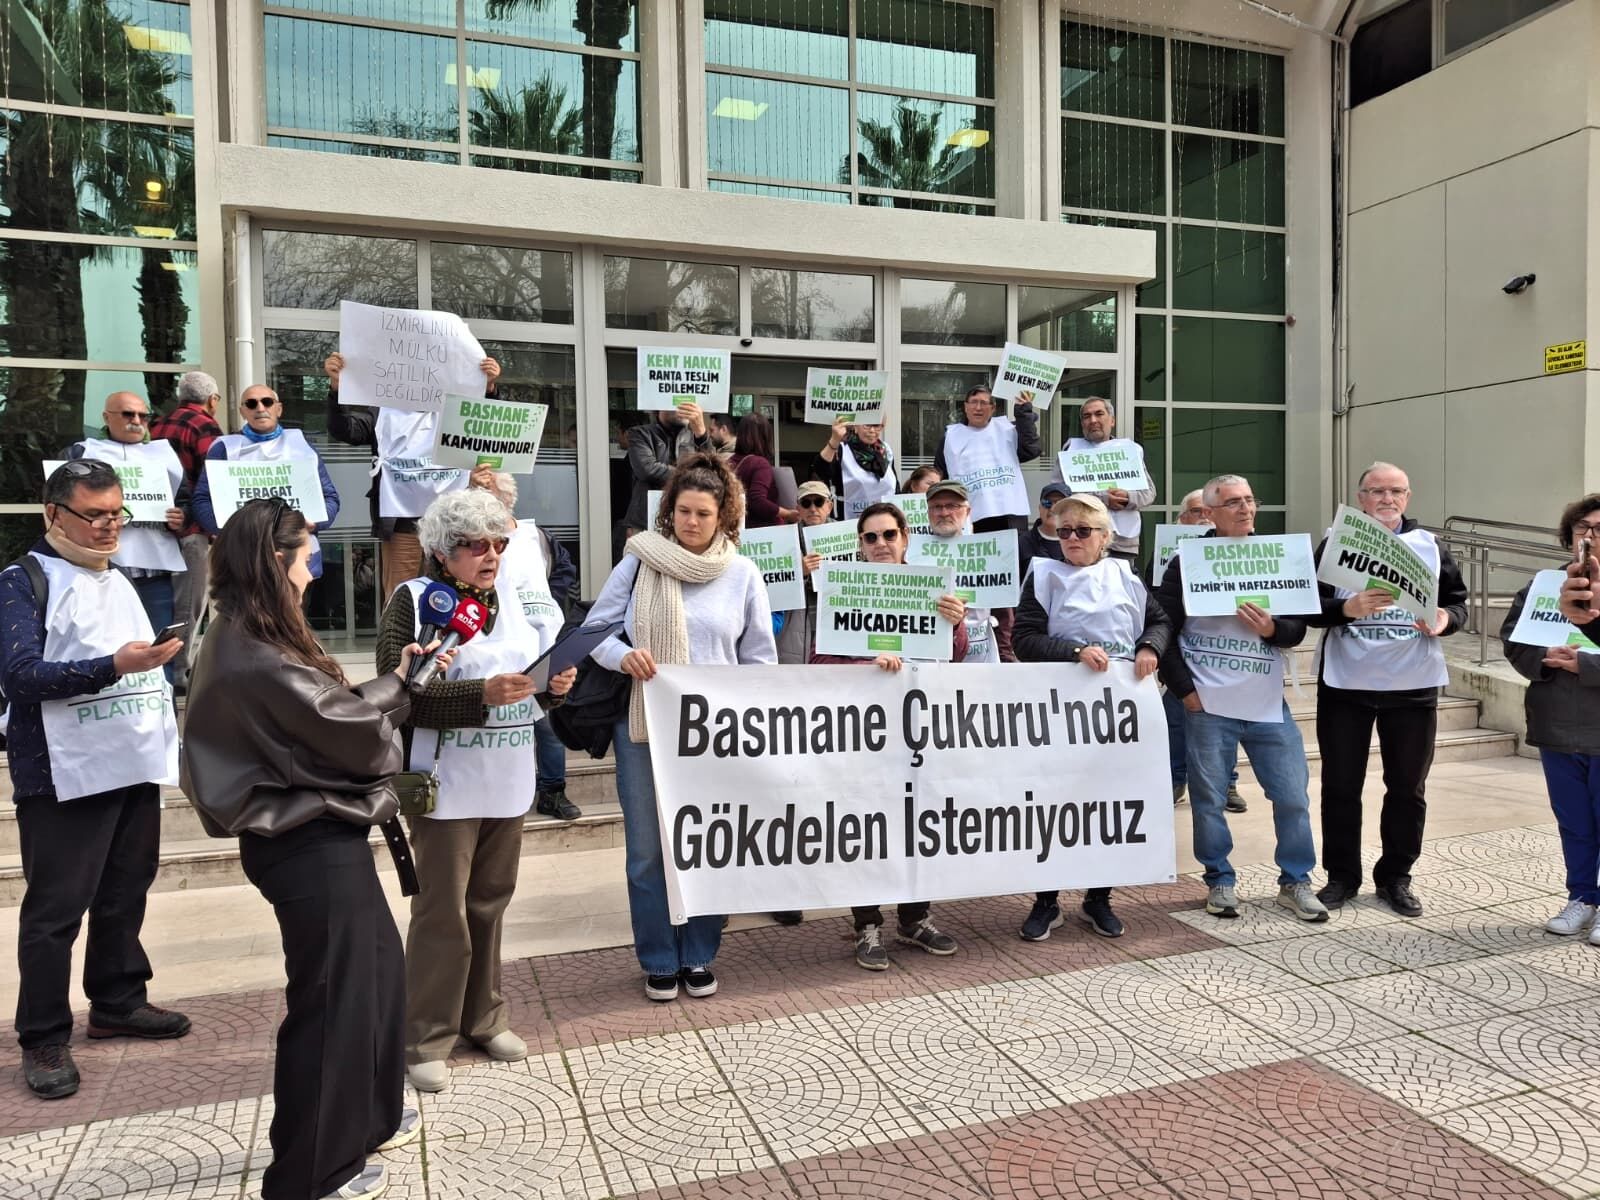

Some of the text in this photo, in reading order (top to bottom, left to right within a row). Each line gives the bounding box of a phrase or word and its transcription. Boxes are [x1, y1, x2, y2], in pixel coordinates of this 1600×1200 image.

[647, 353, 722, 370] KENT HAKKI
[649, 369, 719, 383] RANTA TESLİM
[827, 374, 869, 387] NE AVM
[1003, 370, 1017, 383] BU
[1016, 374, 1036, 388] KENT
[658, 381, 710, 395] EDİLEMEZ!
[811, 386, 883, 400] NE GÖKDELEN
[460, 401, 530, 423] BASMANE
[811, 399, 881, 412] KAMUSAL ALAN!
[464, 419, 522, 439] ÇUKURU
[441, 433, 535, 454] KAMUNUNDUR!
[1071, 449, 1129, 466] SÖZ, YETKİ,
[228, 464, 292, 477] KAMUYA AİT
[1084, 461, 1119, 473] KARAR
[239, 476, 289, 487] OLANDAN
[1069, 470, 1140, 482] İZMİR HALKINA!
[238, 485, 293, 498] FERAGAT
[966, 478, 1015, 494] LATFORMU
[123, 493, 167, 502] ZASIDIR!
[902, 499, 917, 511] NE
[1343, 514, 1389, 543] BİRLİKTE
[922, 538, 1001, 559] SÖZ, YETKİ,
[1340, 535, 1379, 557] BİRLİKTE
[1354, 530, 1390, 554] BİRLİKTE
[1203, 543, 1285, 561] BASMANE
[1212, 559, 1280, 580] ÇUKURU
[763, 570, 795, 587] ÇEKİN!
[828, 568, 947, 590] BİRLİKTE SAVUNMAK,
[1239, 579, 1311, 591] HAFIZASIDIR!
[1338, 549, 1428, 608] MÜCADELE!
[841, 585, 932, 600] BİRLİKTE KORUMAK,
[829, 596, 869, 608] BİRLİKTE
[872, 598, 923, 611] KAZANMAK
[833, 608, 936, 635] MÜCADELE!
[1340, 627, 1422, 641] PLATFORM
[1183, 651, 1271, 675] PLATFORMU
[77, 695, 166, 724] PLATFO
[677, 686, 1140, 768] Basmane Çukuru'nda
[440, 729, 533, 748] PLATFOR
[673, 781, 1147, 872] Gökdelen İstemiyoruz
